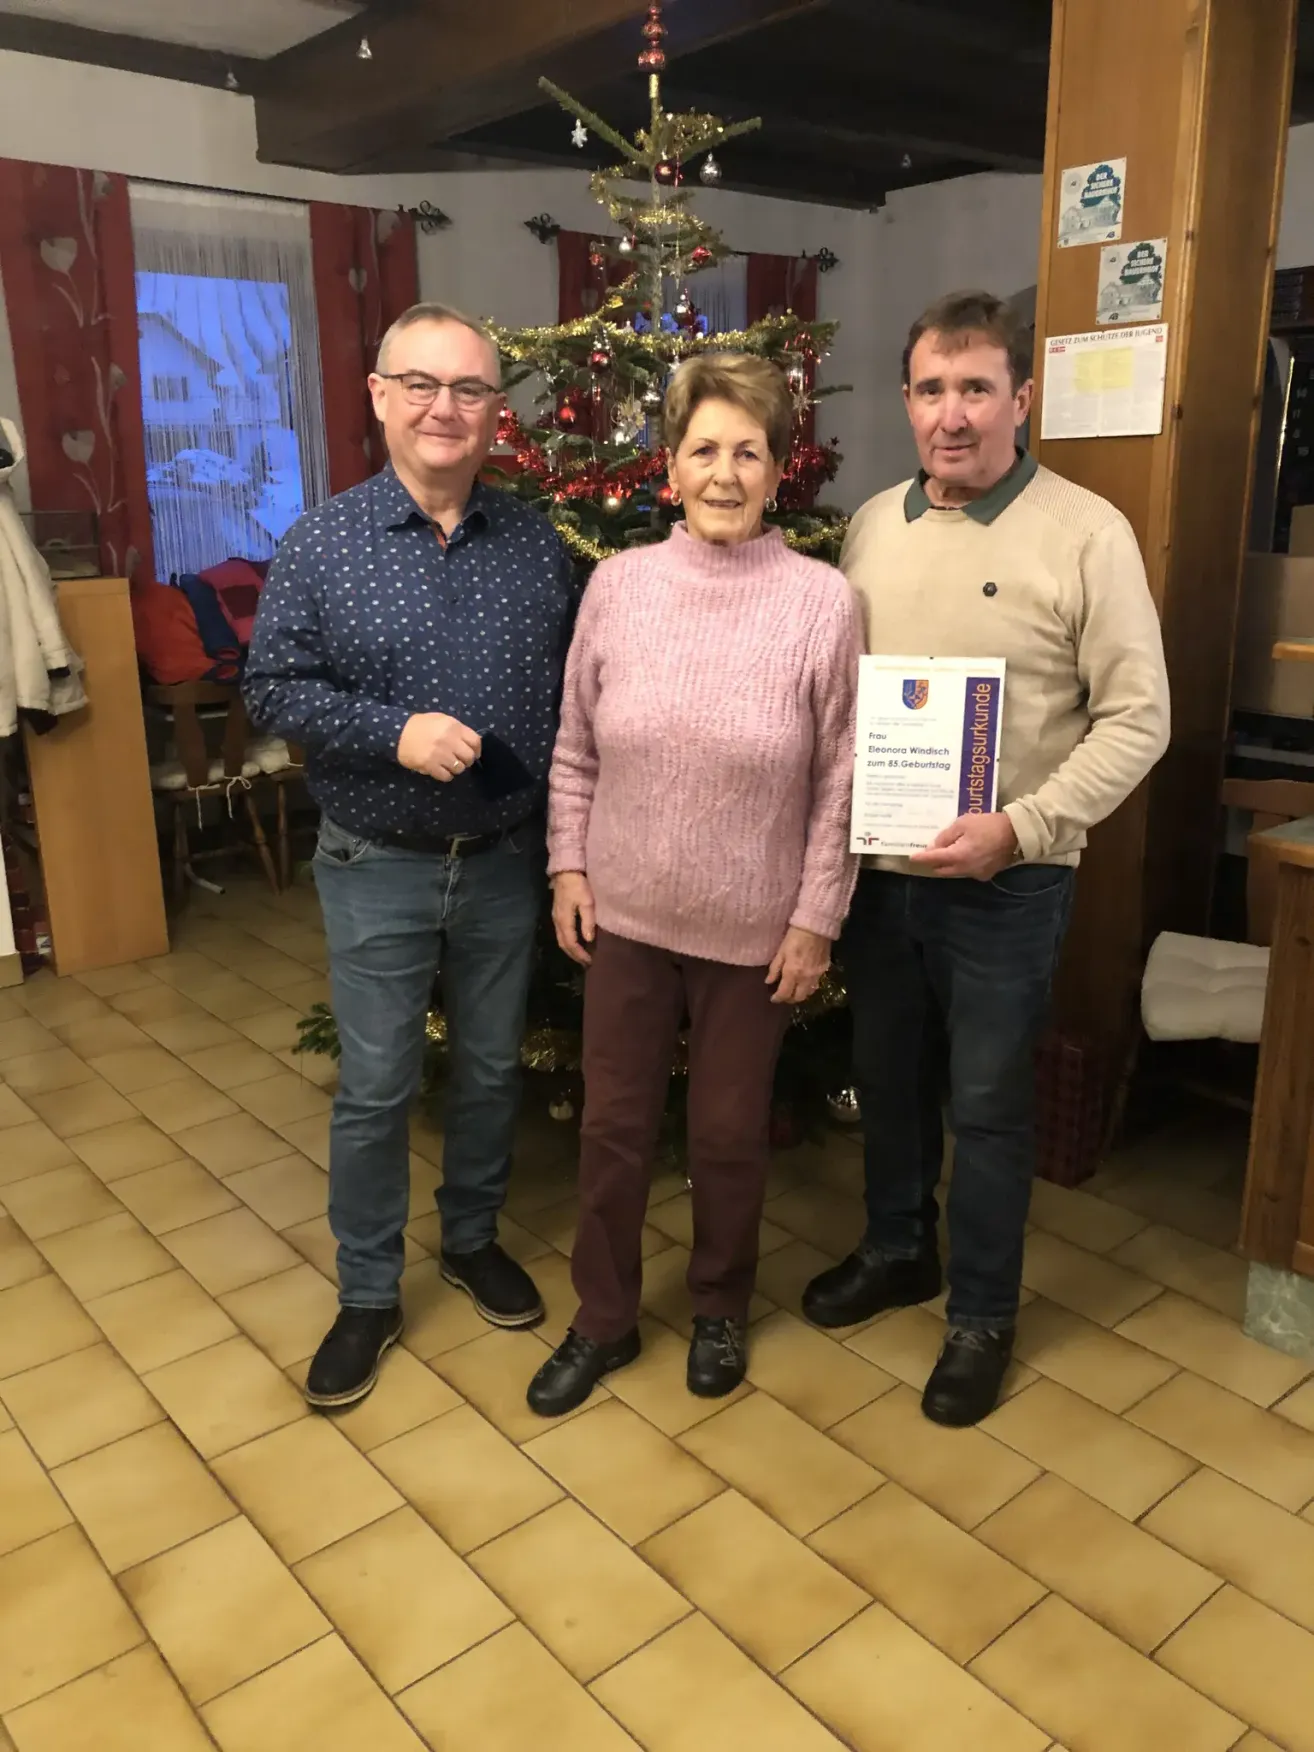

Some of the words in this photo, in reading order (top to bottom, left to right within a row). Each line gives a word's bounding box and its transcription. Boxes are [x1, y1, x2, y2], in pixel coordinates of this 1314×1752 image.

[1050, 337, 1072, 346] GESETZ
[1073, 336, 1089, 344] ZUM
[1090, 333, 1118, 342] SCHUTZE
[1120, 331, 1133, 339] DER
[1135, 328, 1163, 338] JUGEND
[868, 732, 887, 740] Frau
[868, 745, 907, 754] Eleonora
[909, 746, 950, 756] Windisch
